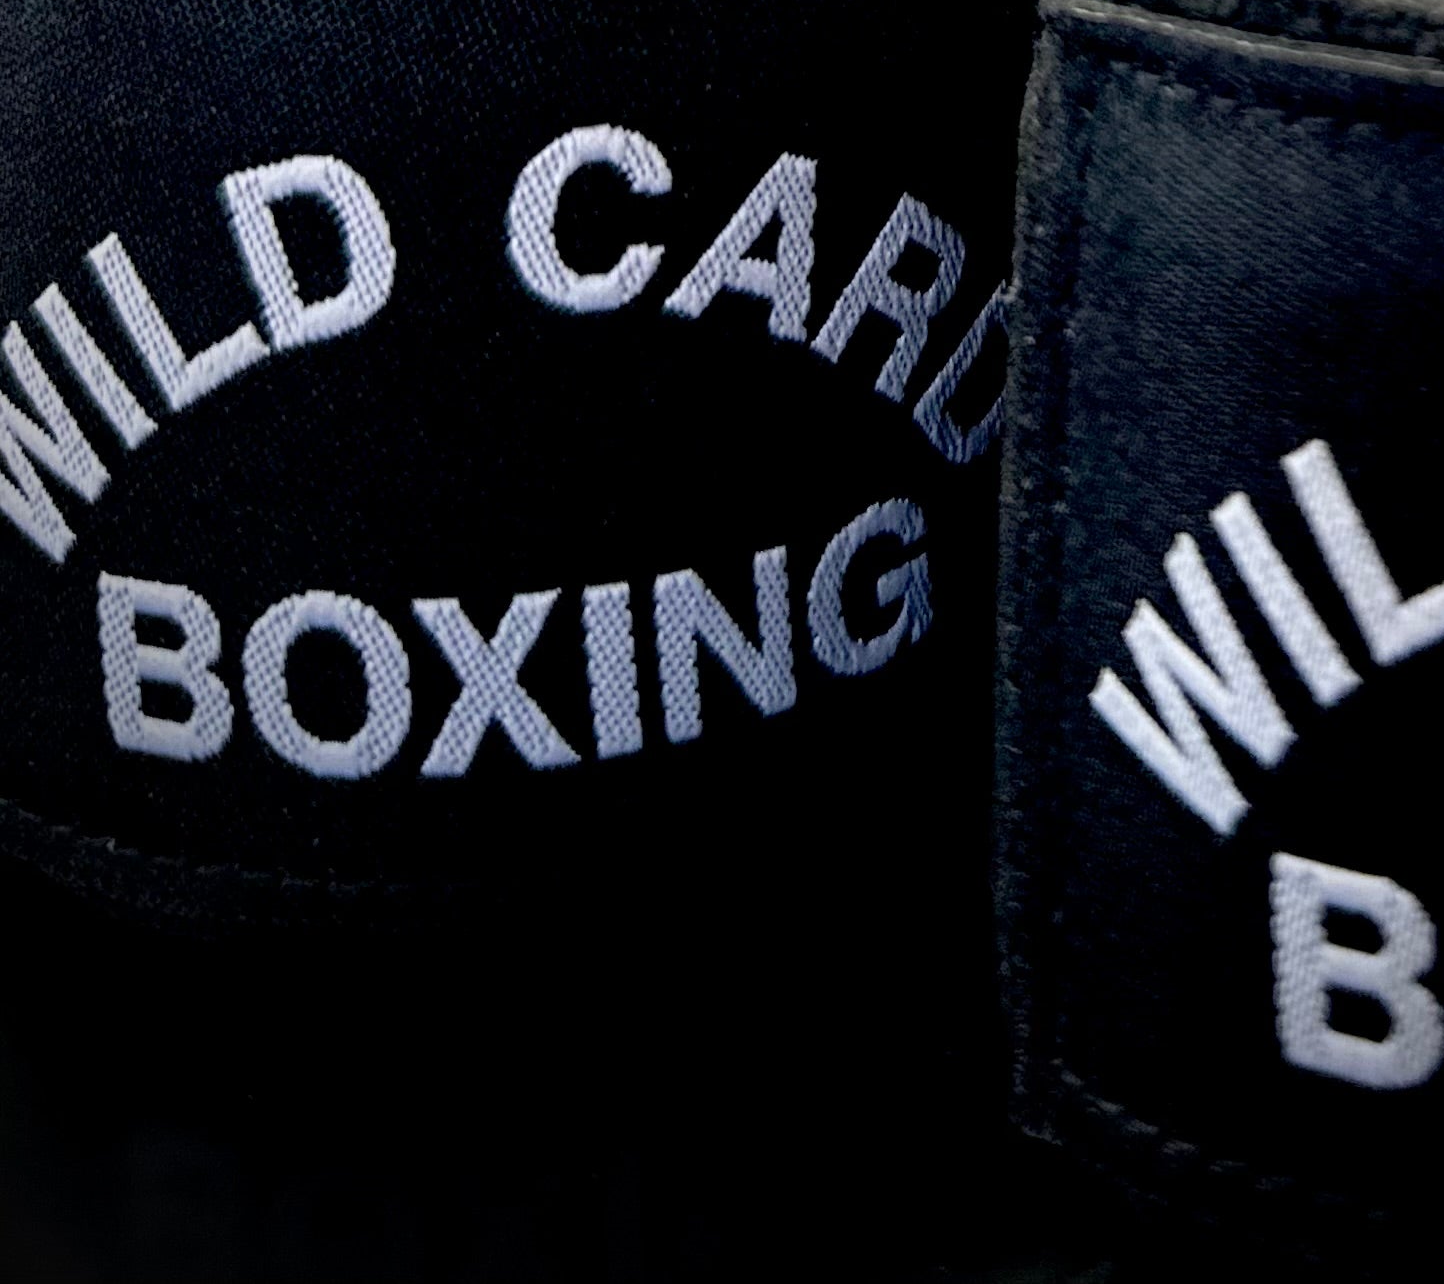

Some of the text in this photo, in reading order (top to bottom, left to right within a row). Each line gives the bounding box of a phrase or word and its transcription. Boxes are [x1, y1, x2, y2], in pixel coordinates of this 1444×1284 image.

[0, 122, 1006, 564] WILD CARD
[96, 497, 933, 780] BOXING
